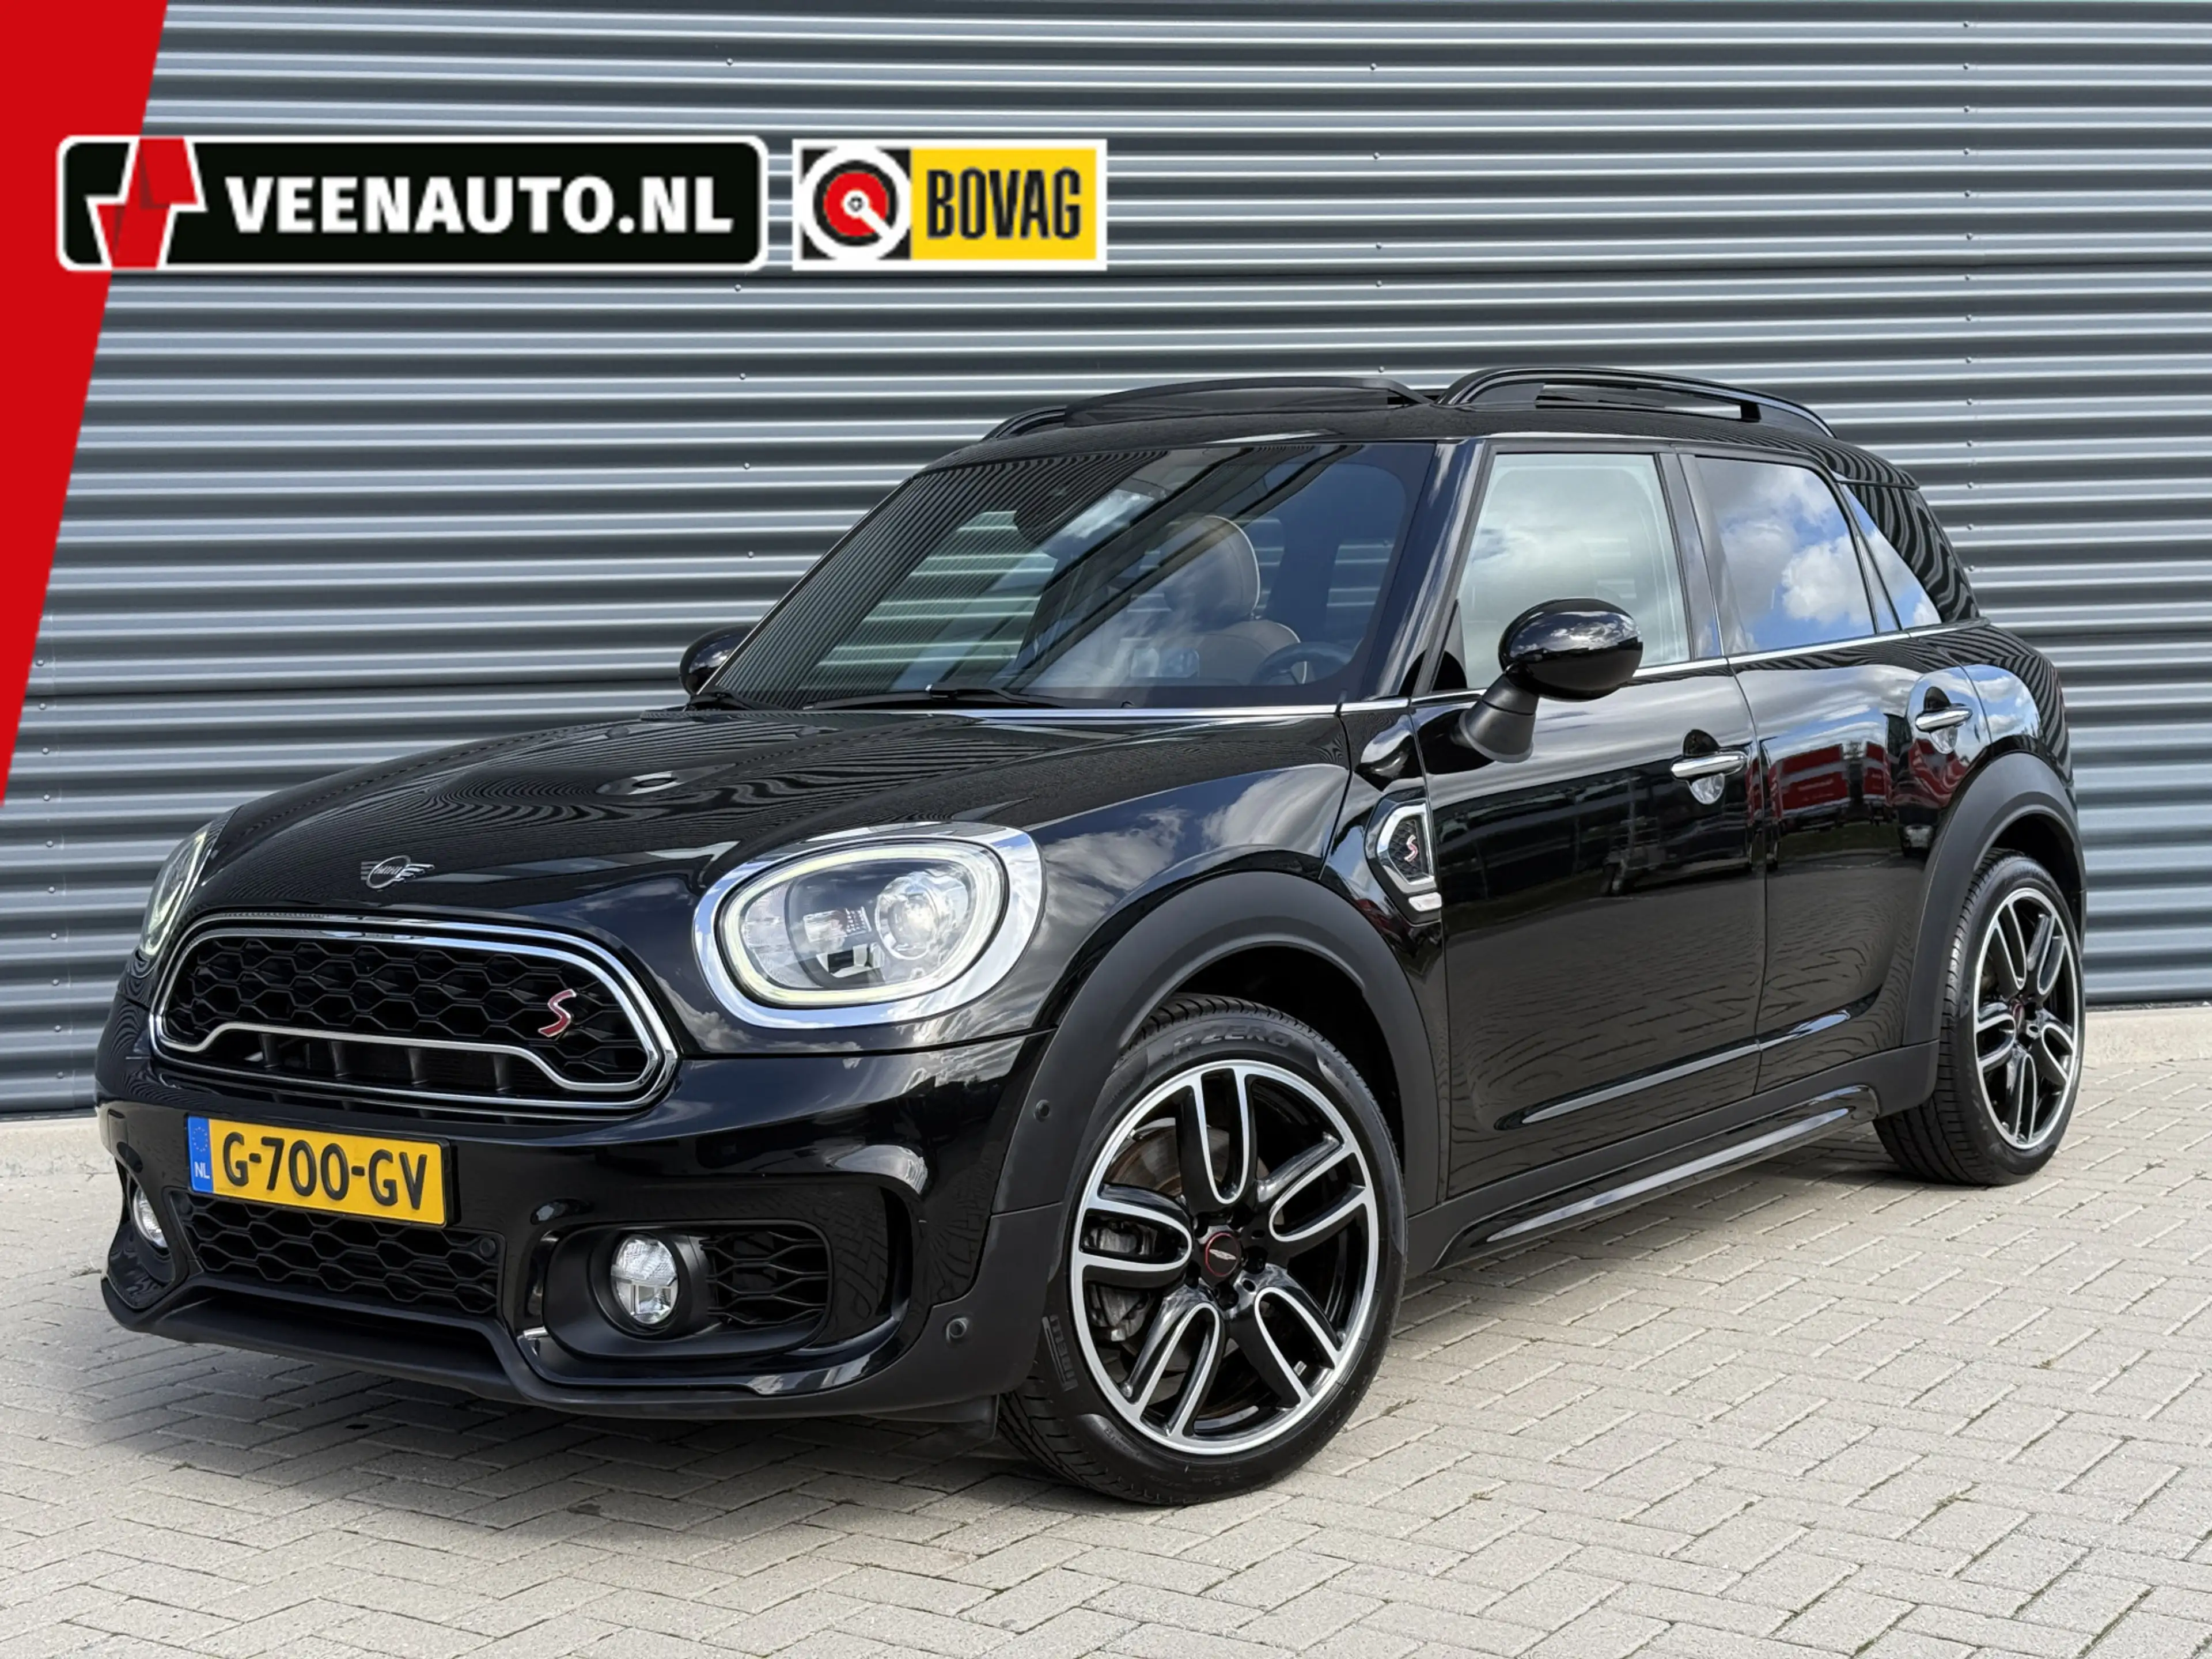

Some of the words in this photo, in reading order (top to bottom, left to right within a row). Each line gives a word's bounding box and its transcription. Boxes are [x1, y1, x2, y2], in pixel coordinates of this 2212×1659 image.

[537, 988, 577, 1038] S
[1200, 1025, 1294, 1047] ZERO
[194, 1161, 211, 1180] NL
[222, 1131, 427, 1210] G-700-GV
